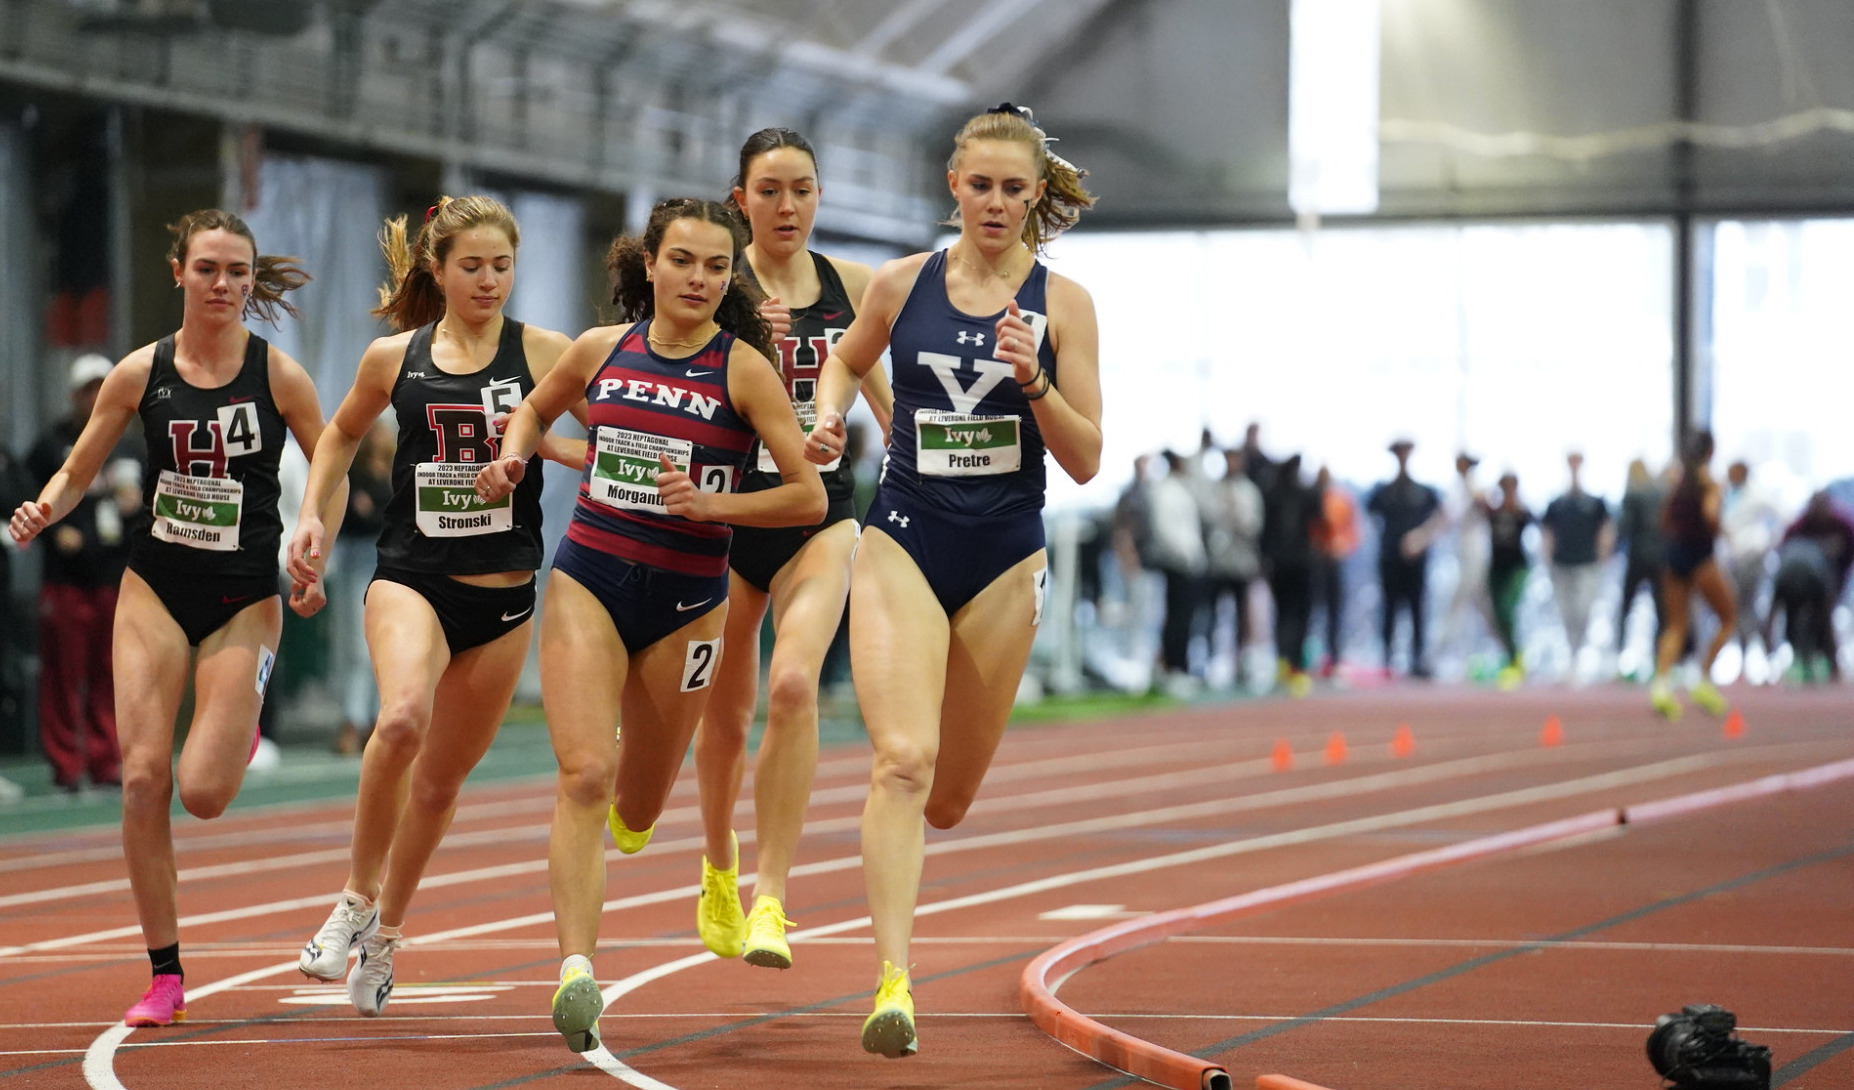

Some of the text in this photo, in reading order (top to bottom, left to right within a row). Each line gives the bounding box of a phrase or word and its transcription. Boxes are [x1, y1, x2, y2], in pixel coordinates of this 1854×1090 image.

[776, 335, 828, 403] H
[917, 351, 1016, 414] Y
[596, 378, 722, 421] PENN
[226, 406, 256, 451] 4
[426, 404, 499, 463] B
[616, 431, 669, 446] 2023 HEPTAGONAL
[945, 427, 975, 447] Ivy
[168, 420, 231, 479] H
[607, 444, 614, 452] AT
[614, 446, 641, 457] LEVERONE
[641, 452, 657, 460] FIELD
[615, 439, 630, 447] TRACK
[648, 445, 690, 456] CHAMPIONSHIPS
[618, 459, 646, 482] Ivy
[949, 454, 990, 468] Pretre
[428, 478, 437, 486] AT
[706, 468, 726, 494] 2
[176, 499, 202, 522] Ivy
[442, 490, 472, 510] Ivy
[166, 522, 220, 543] Ramsden
[438, 513, 492, 529] Stronski
[686, 643, 713, 690] 2
